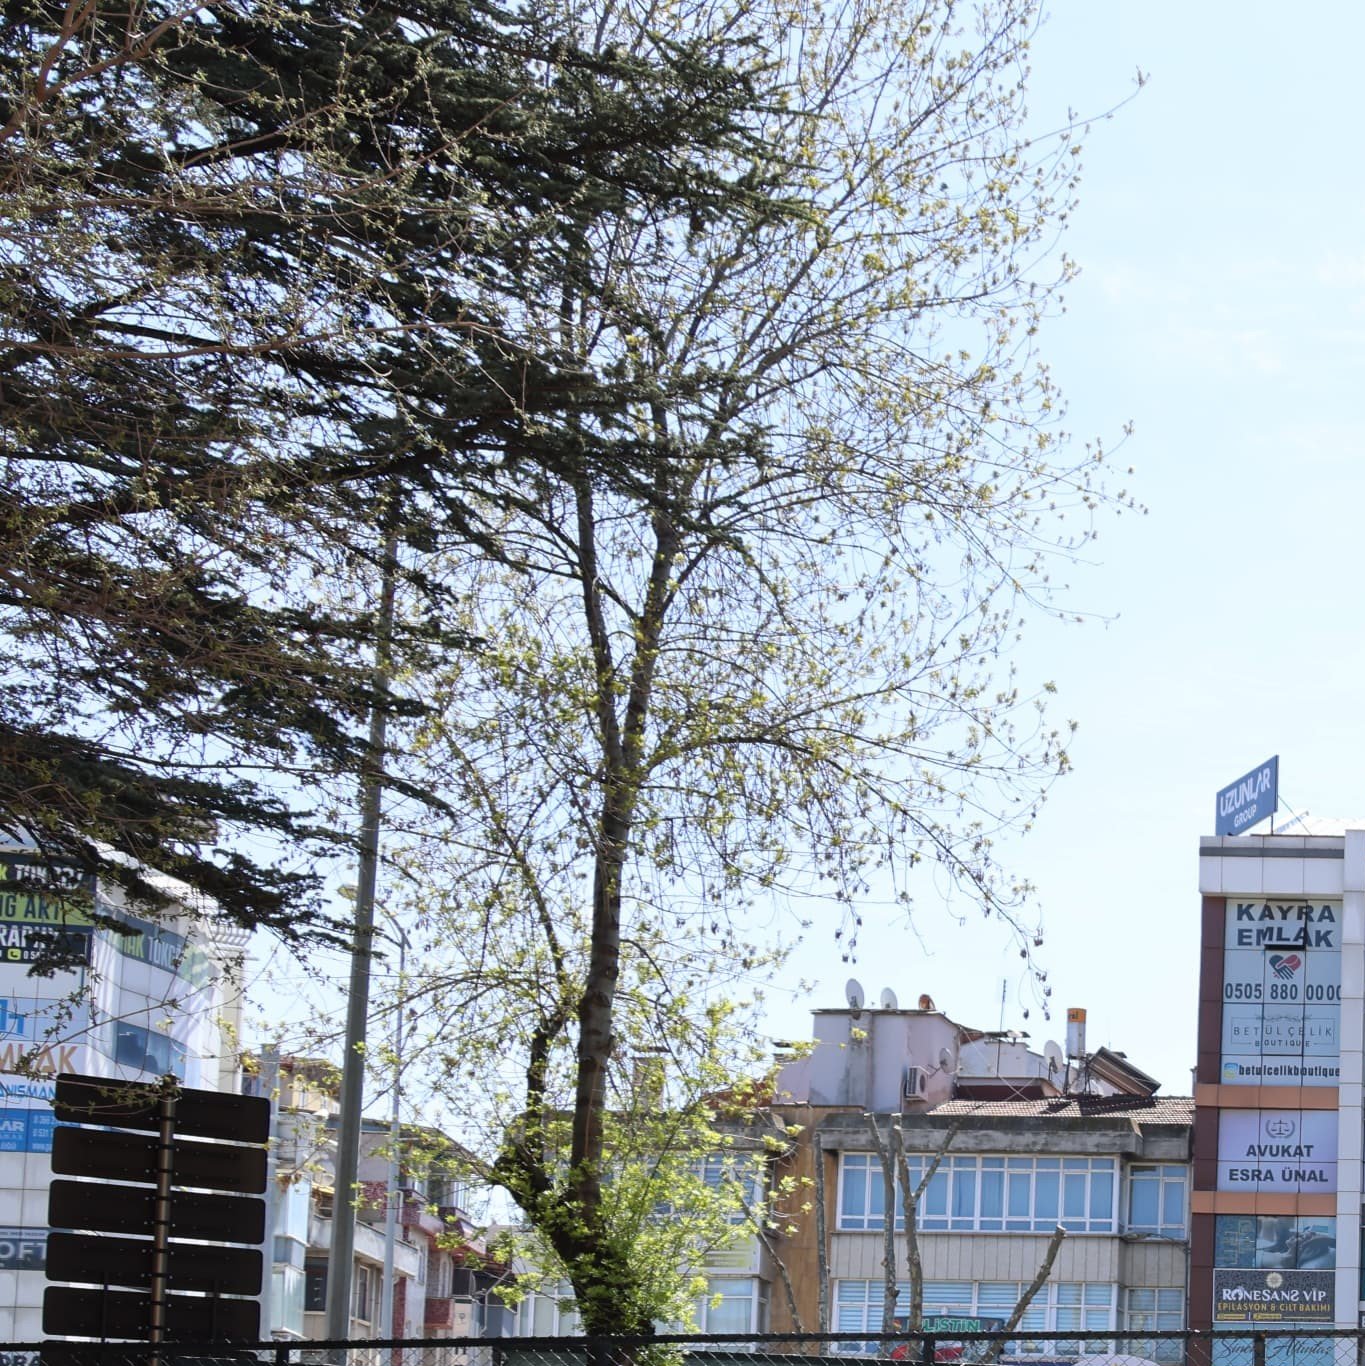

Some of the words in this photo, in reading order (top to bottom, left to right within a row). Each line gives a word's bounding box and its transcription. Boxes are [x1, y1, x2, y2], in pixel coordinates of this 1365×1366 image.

[1220, 768, 1271, 817] UZUNLAR
[1234, 805, 1257, 828] GROUP
[1236, 903, 1336, 922] KAYRA
[1237, 926, 1334, 948] EMLAK
[1225, 983, 1262, 999] 0505
[1270, 984, 1298, 1000] 880
[1233, 1024, 1282, 1036] BETÜL
[1246, 1144, 1314, 1158] AVUKAT
[1228, 1168, 1275, 1182] ESRA
[1281, 1166, 1329, 1183] ÜNAL
